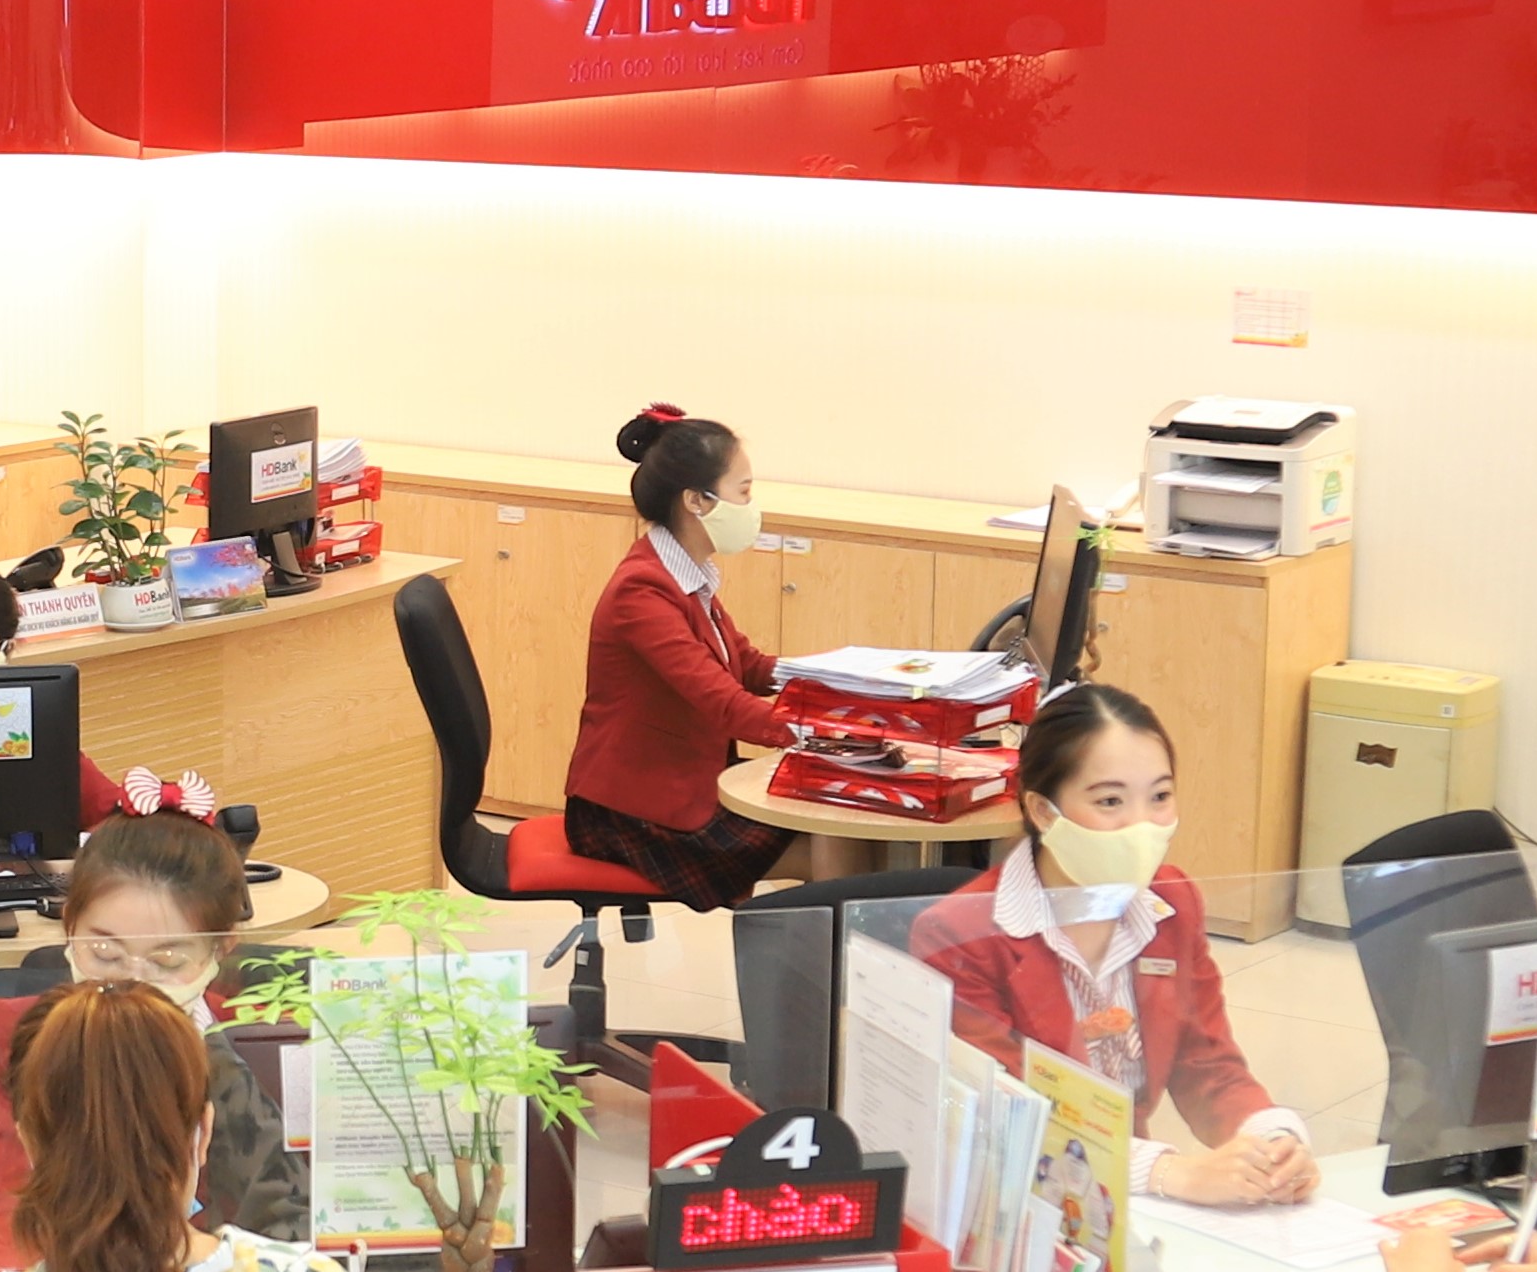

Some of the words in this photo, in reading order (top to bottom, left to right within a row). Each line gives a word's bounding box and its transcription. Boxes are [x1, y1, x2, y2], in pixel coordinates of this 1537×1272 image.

[261, 458, 298, 478] HDBank
[29, 599, 62, 614] THANH
[331, 980, 386, 991] HDBank
[762, 1116, 821, 1170] 4
[680, 1183, 861, 1246] chào
